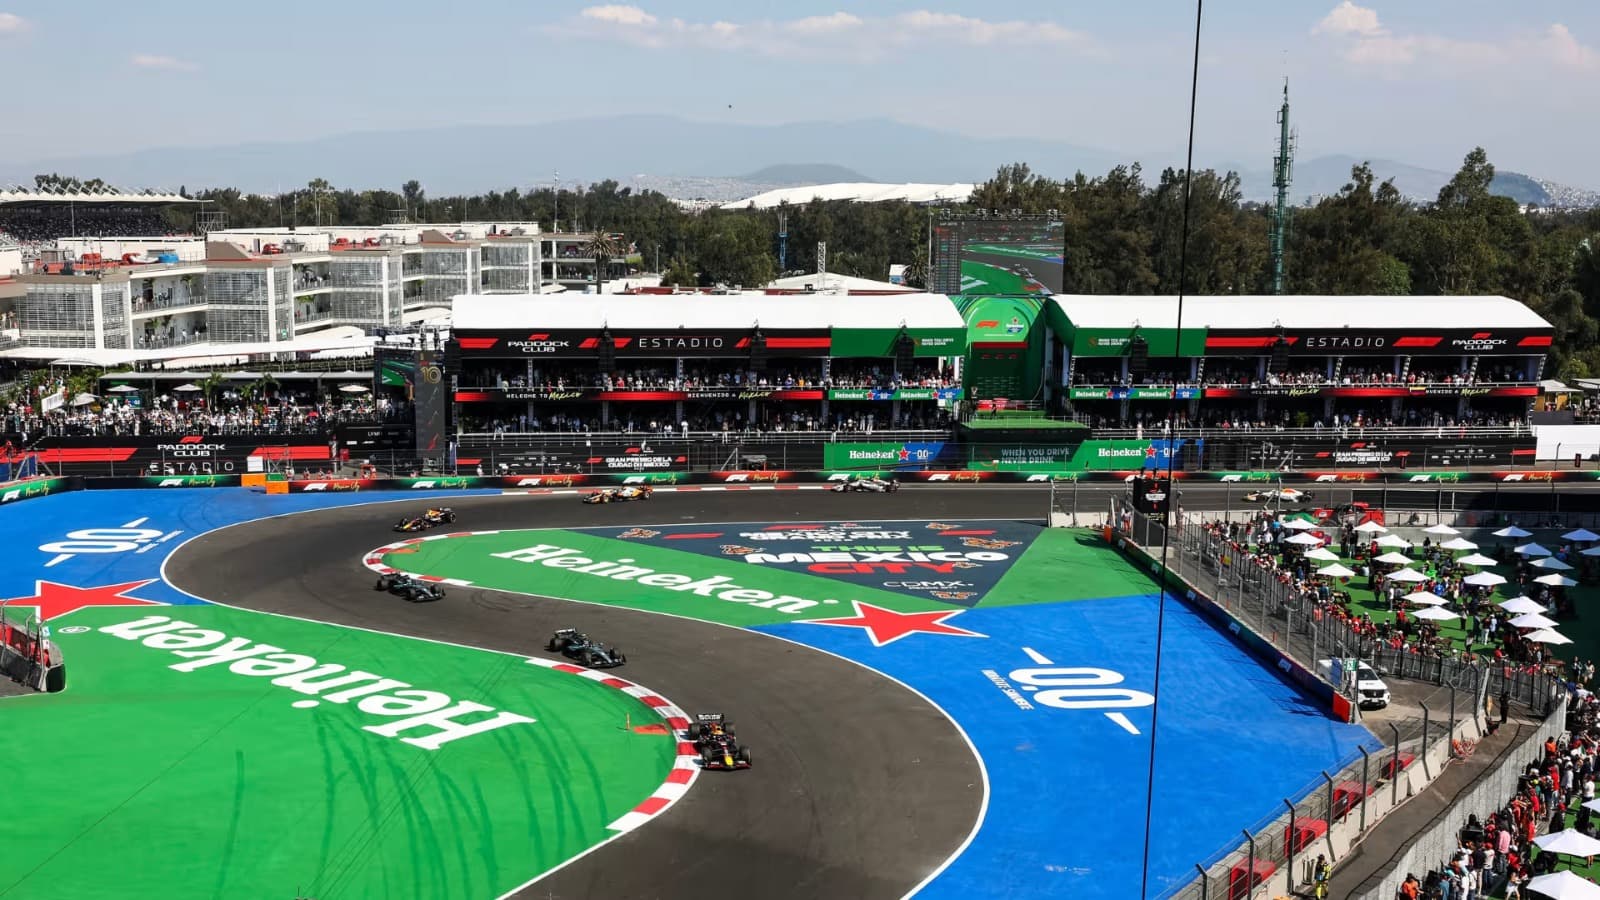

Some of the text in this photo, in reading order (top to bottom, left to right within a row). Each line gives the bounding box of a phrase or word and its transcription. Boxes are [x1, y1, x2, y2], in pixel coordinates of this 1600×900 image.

[638, 337, 723, 348] ESTADIO
[1306, 337, 1385, 347] ESTADIO
[834, 391, 864, 399] Heineken
[1075, 390, 1103, 398] Heineken
[1138, 390, 1167, 398] Heineken
[849, 450, 895, 459] Heineken
[1002, 448, 1070, 456] WHEN YOU DRIVE
[1098, 448, 1142, 457] Heineken
[1002, 456, 1054, 464] NEVER DRINK
[150, 462, 234, 472] ESTADIO
[744, 552, 1010, 564] MEXICO
[807, 562, 955, 574] CITY
[489, 543, 818, 613] Heineken
[97, 615, 537, 751] Heineken
